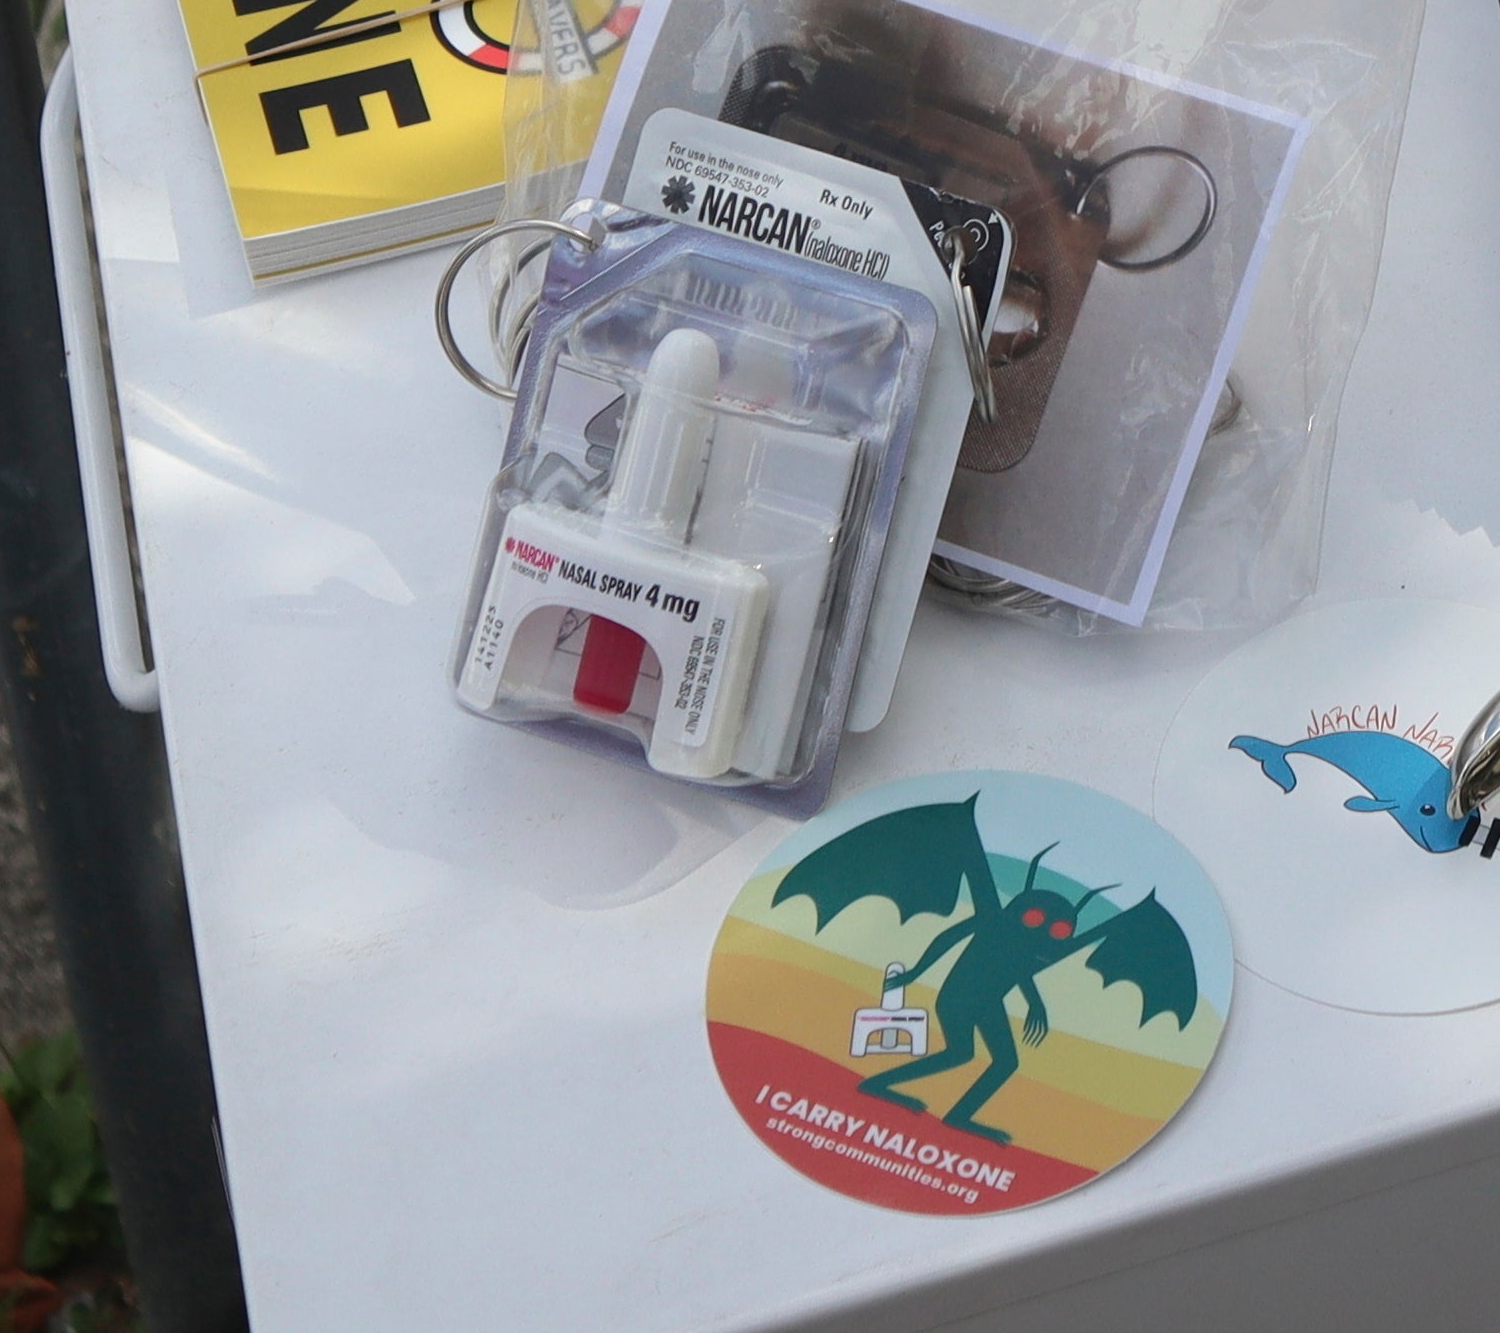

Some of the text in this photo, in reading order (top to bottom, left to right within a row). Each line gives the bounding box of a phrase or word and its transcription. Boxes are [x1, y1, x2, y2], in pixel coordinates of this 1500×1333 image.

[665, 155, 771, 199] NDC 69547-353-02
[668, 141, 785, 189] For use in the nose only
[819, 189, 875, 221] Rx Only
[803, 232, 865, 274] (naloxone
[557, 559, 598, 590] NASAL
[599, 573, 644, 603] SPRAY
[644, 584, 662, 609] 4
[660, 592, 701, 624] mg
[1306, 704, 1398, 741] NARCAN
[754, 1084, 1017, 1193] I CARRY NALOXONE
[765, 1116, 980, 1205] strongcommunities.org
